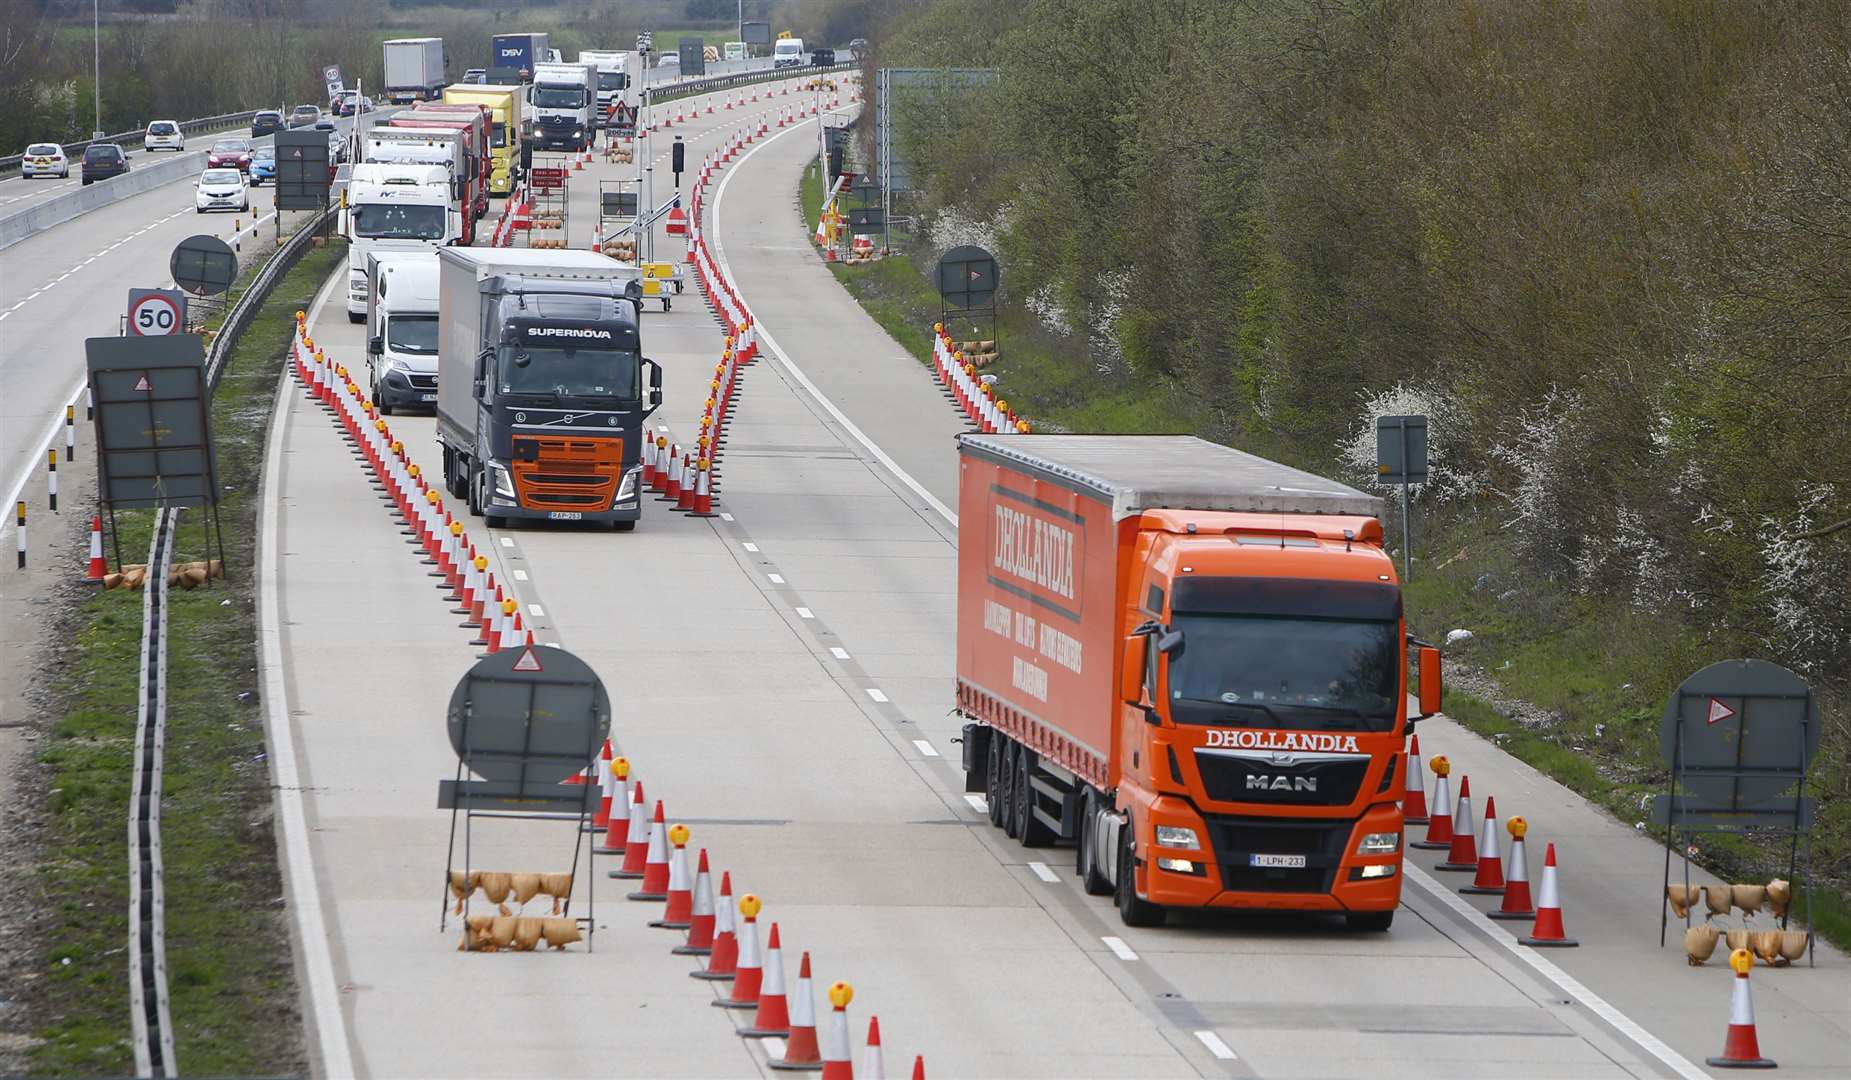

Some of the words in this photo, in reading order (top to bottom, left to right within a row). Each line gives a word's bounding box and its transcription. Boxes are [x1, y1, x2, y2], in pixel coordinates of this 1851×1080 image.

[502, 48, 523, 57] DSV
[140, 309, 173, 328] 50
[528, 327, 611, 339] SUPERNOVA
[994, 504, 1074, 600] DHOLLANDIA
[1206, 730, 1359, 752] DHOLLANDIA
[1246, 775, 1317, 791] MAN
